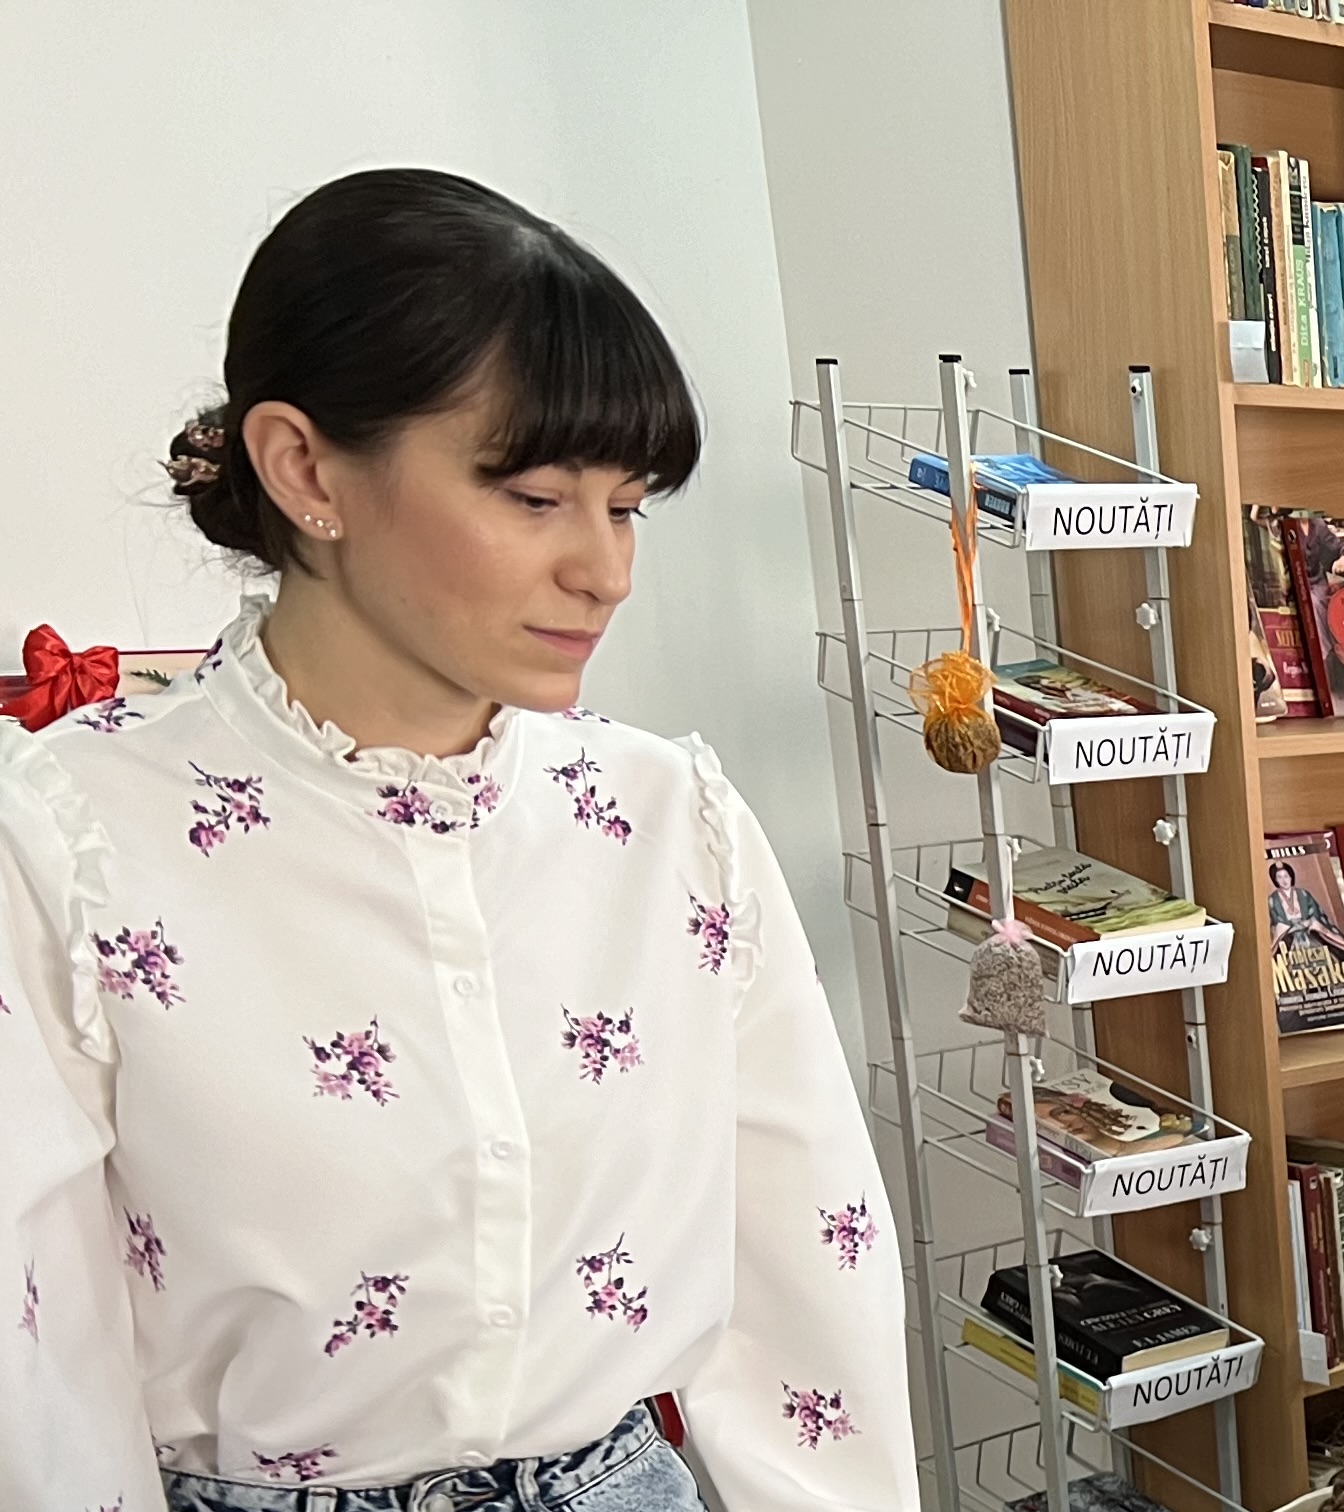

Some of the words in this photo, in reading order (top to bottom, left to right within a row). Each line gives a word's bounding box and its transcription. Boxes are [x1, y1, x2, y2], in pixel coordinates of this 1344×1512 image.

[1052, 496, 1175, 541] NOUTĂȚI
[1075, 726, 1192, 770] NOUTĂȚI
[1091, 934, 1209, 978] NOUTĂȚI
[1111, 1153, 1229, 1199] NOUTĂȚI
[1132, 1355, 1245, 1408] NOUTĂȚI
